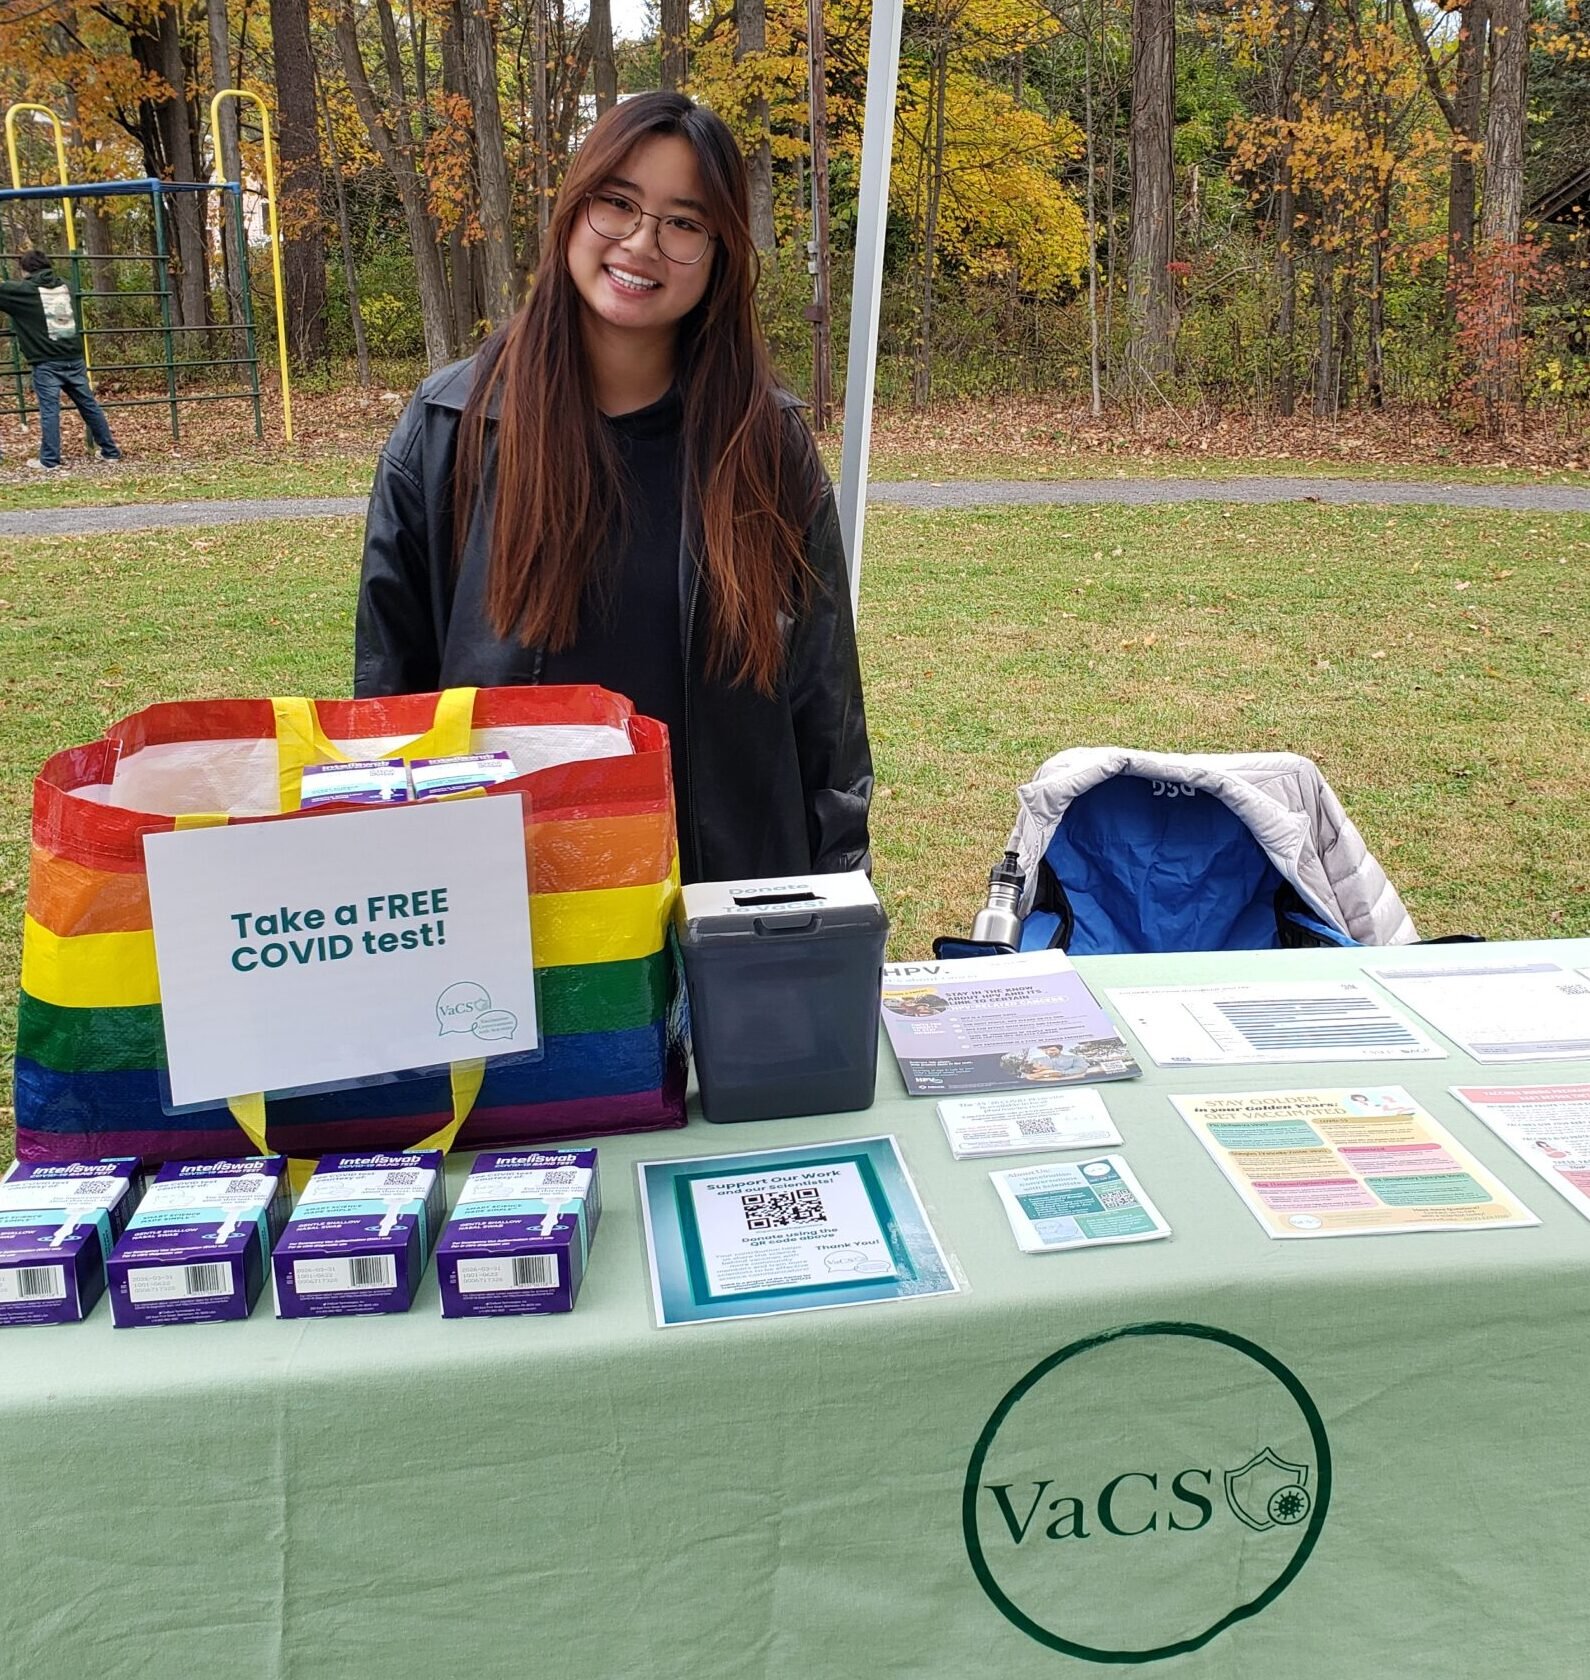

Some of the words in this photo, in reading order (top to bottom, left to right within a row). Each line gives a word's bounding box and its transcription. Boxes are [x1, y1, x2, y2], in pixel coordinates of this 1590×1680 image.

[729, 883, 809, 895] Donate
[758, 900, 826, 912] VaCS!
[231, 907, 325, 938] Take
[335, 904, 357, 925] a
[368, 888, 449, 921] FREE
[231, 934, 353, 971] COVID
[362, 920, 446, 954] test!
[440, 1002, 474, 1016] VaCS
[1250, 1096, 1320, 1105] GOLDEN
[1242, 1108, 1347, 1119] VACCINATED
[339, 1154, 421, 1166] InteliSwab
[496, 1153, 577, 1165] InteliSwab
[33, 1163, 117, 1175] InteliSwab
[181, 1161, 265, 1173] InteliSwab
[707, 1178, 768, 1191] Support
[801, 1170, 841, 1179] Work
[717, 1188, 742, 1196] and
[769, 1178, 835, 1190] Scientists!
[742, 1234, 784, 1243] Donate
[786, 1230, 817, 1239] using
[816, 1242, 851, 1251] Thank
[984, 1469, 1213, 1544] VaCS
